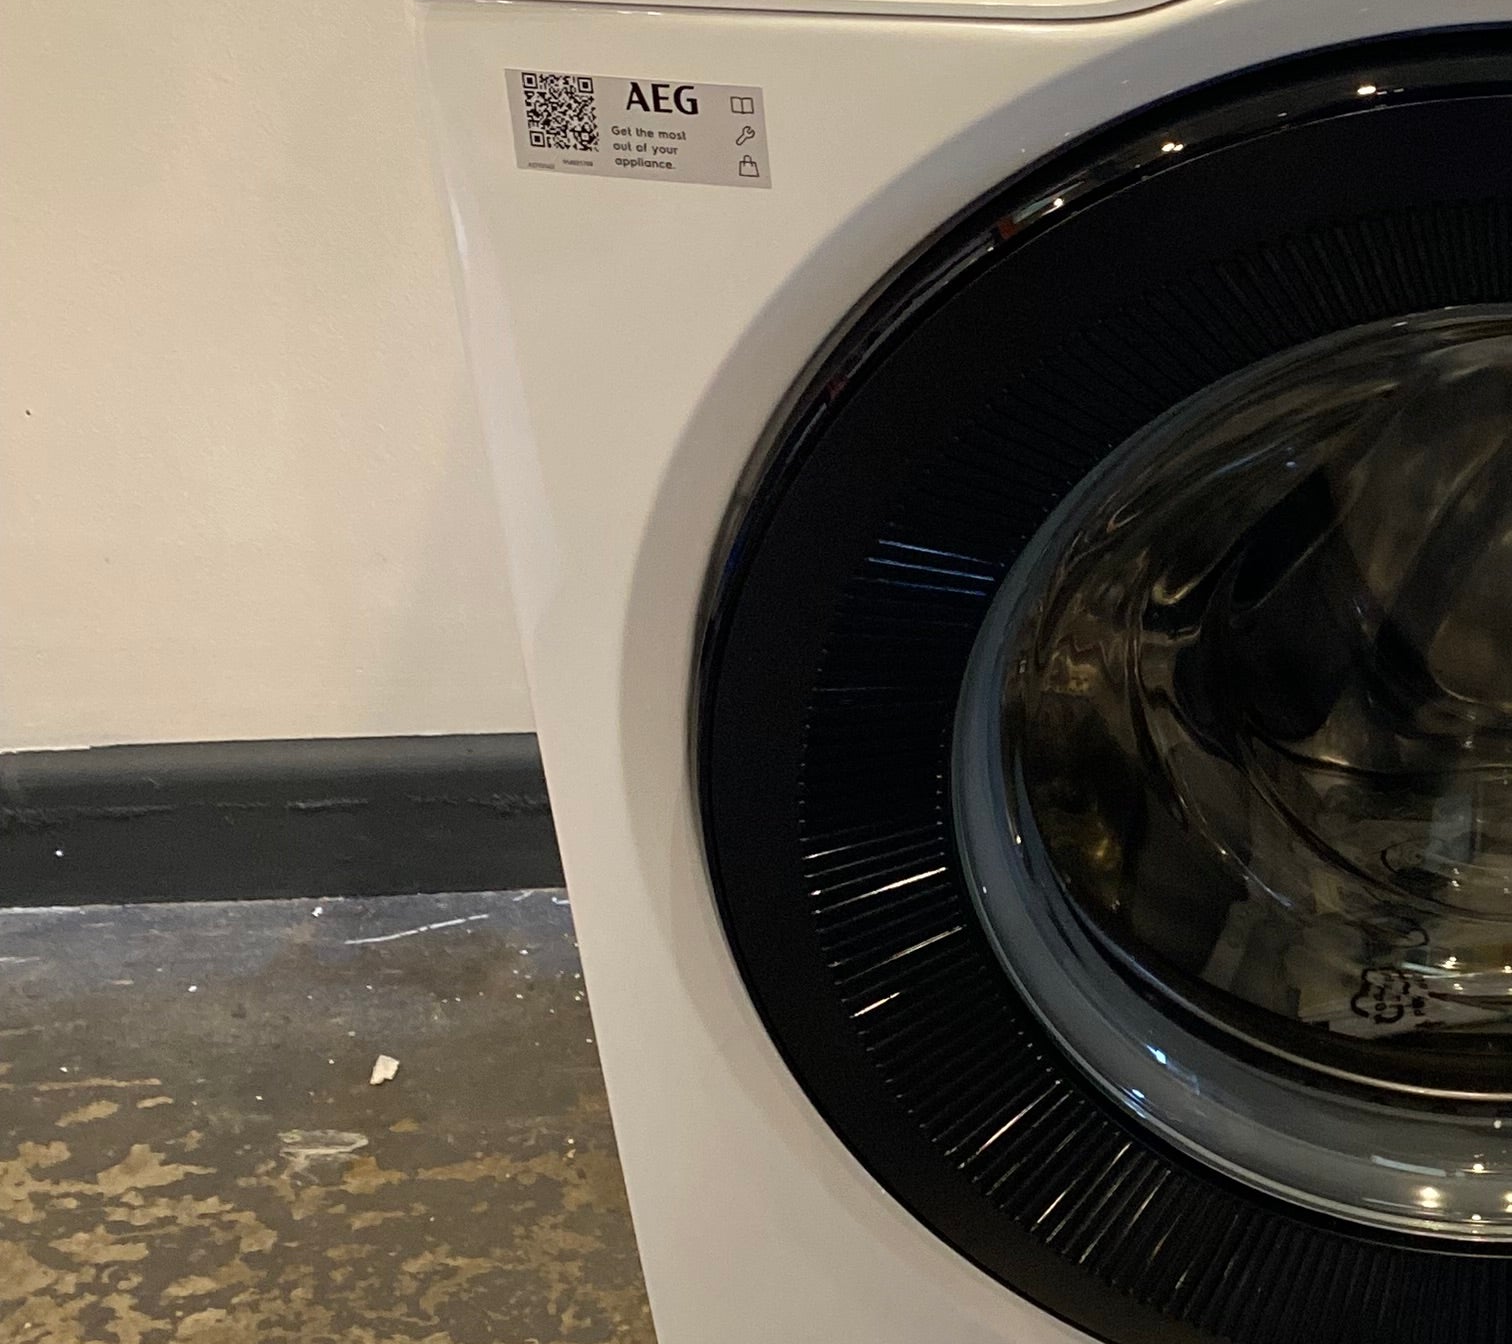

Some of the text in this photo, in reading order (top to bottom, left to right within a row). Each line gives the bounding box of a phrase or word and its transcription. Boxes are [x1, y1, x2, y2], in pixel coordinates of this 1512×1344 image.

[626, 82, 699, 115] AEG
[611, 126, 686, 140] Get the most
[613, 142, 678, 155] out of your
[615, 157, 676, 169] appliance.
